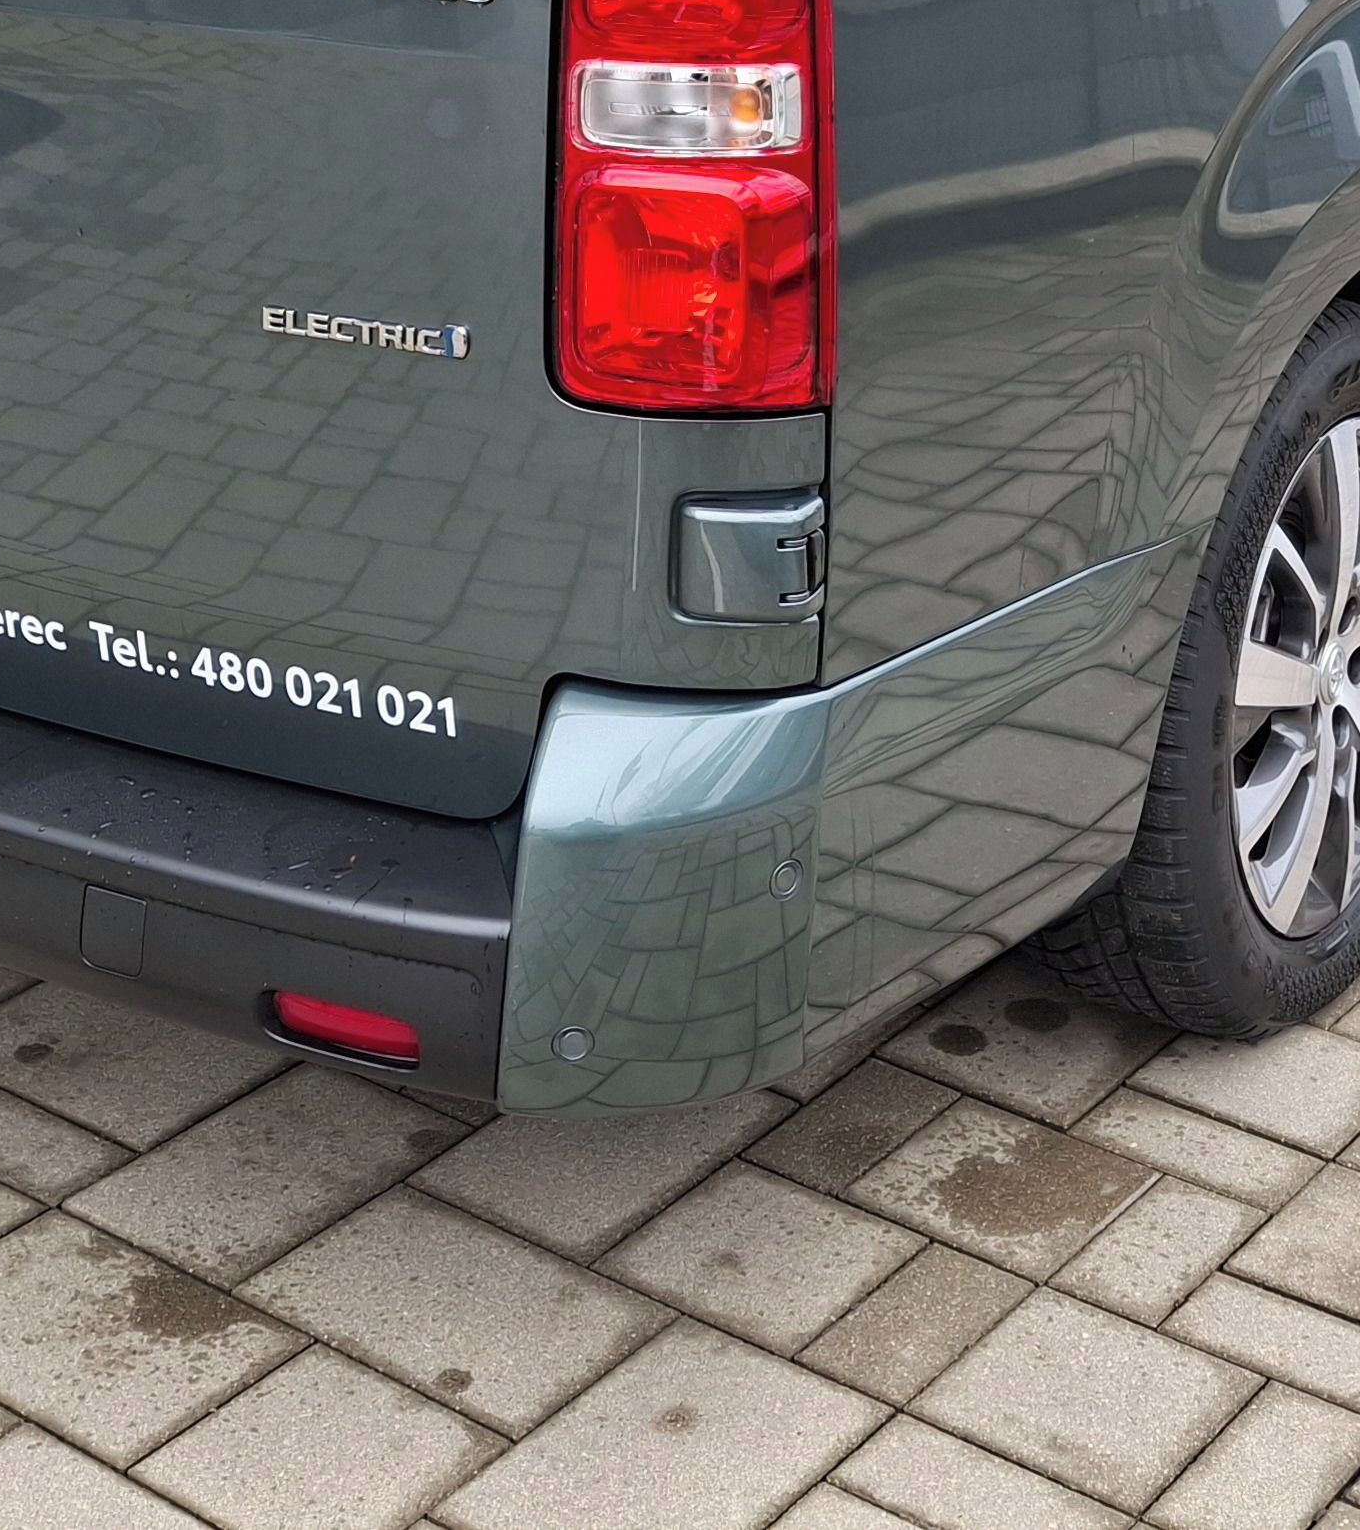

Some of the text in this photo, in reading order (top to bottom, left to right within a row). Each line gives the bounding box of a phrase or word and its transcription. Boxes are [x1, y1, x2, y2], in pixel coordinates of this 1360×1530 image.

[262, 305, 447, 357] ELECTRIC
[87, 620, 181, 680] Tel.:
[190, 647, 273, 699] 480
[285, 665, 363, 720] 021
[376, 684, 458, 738] 021
